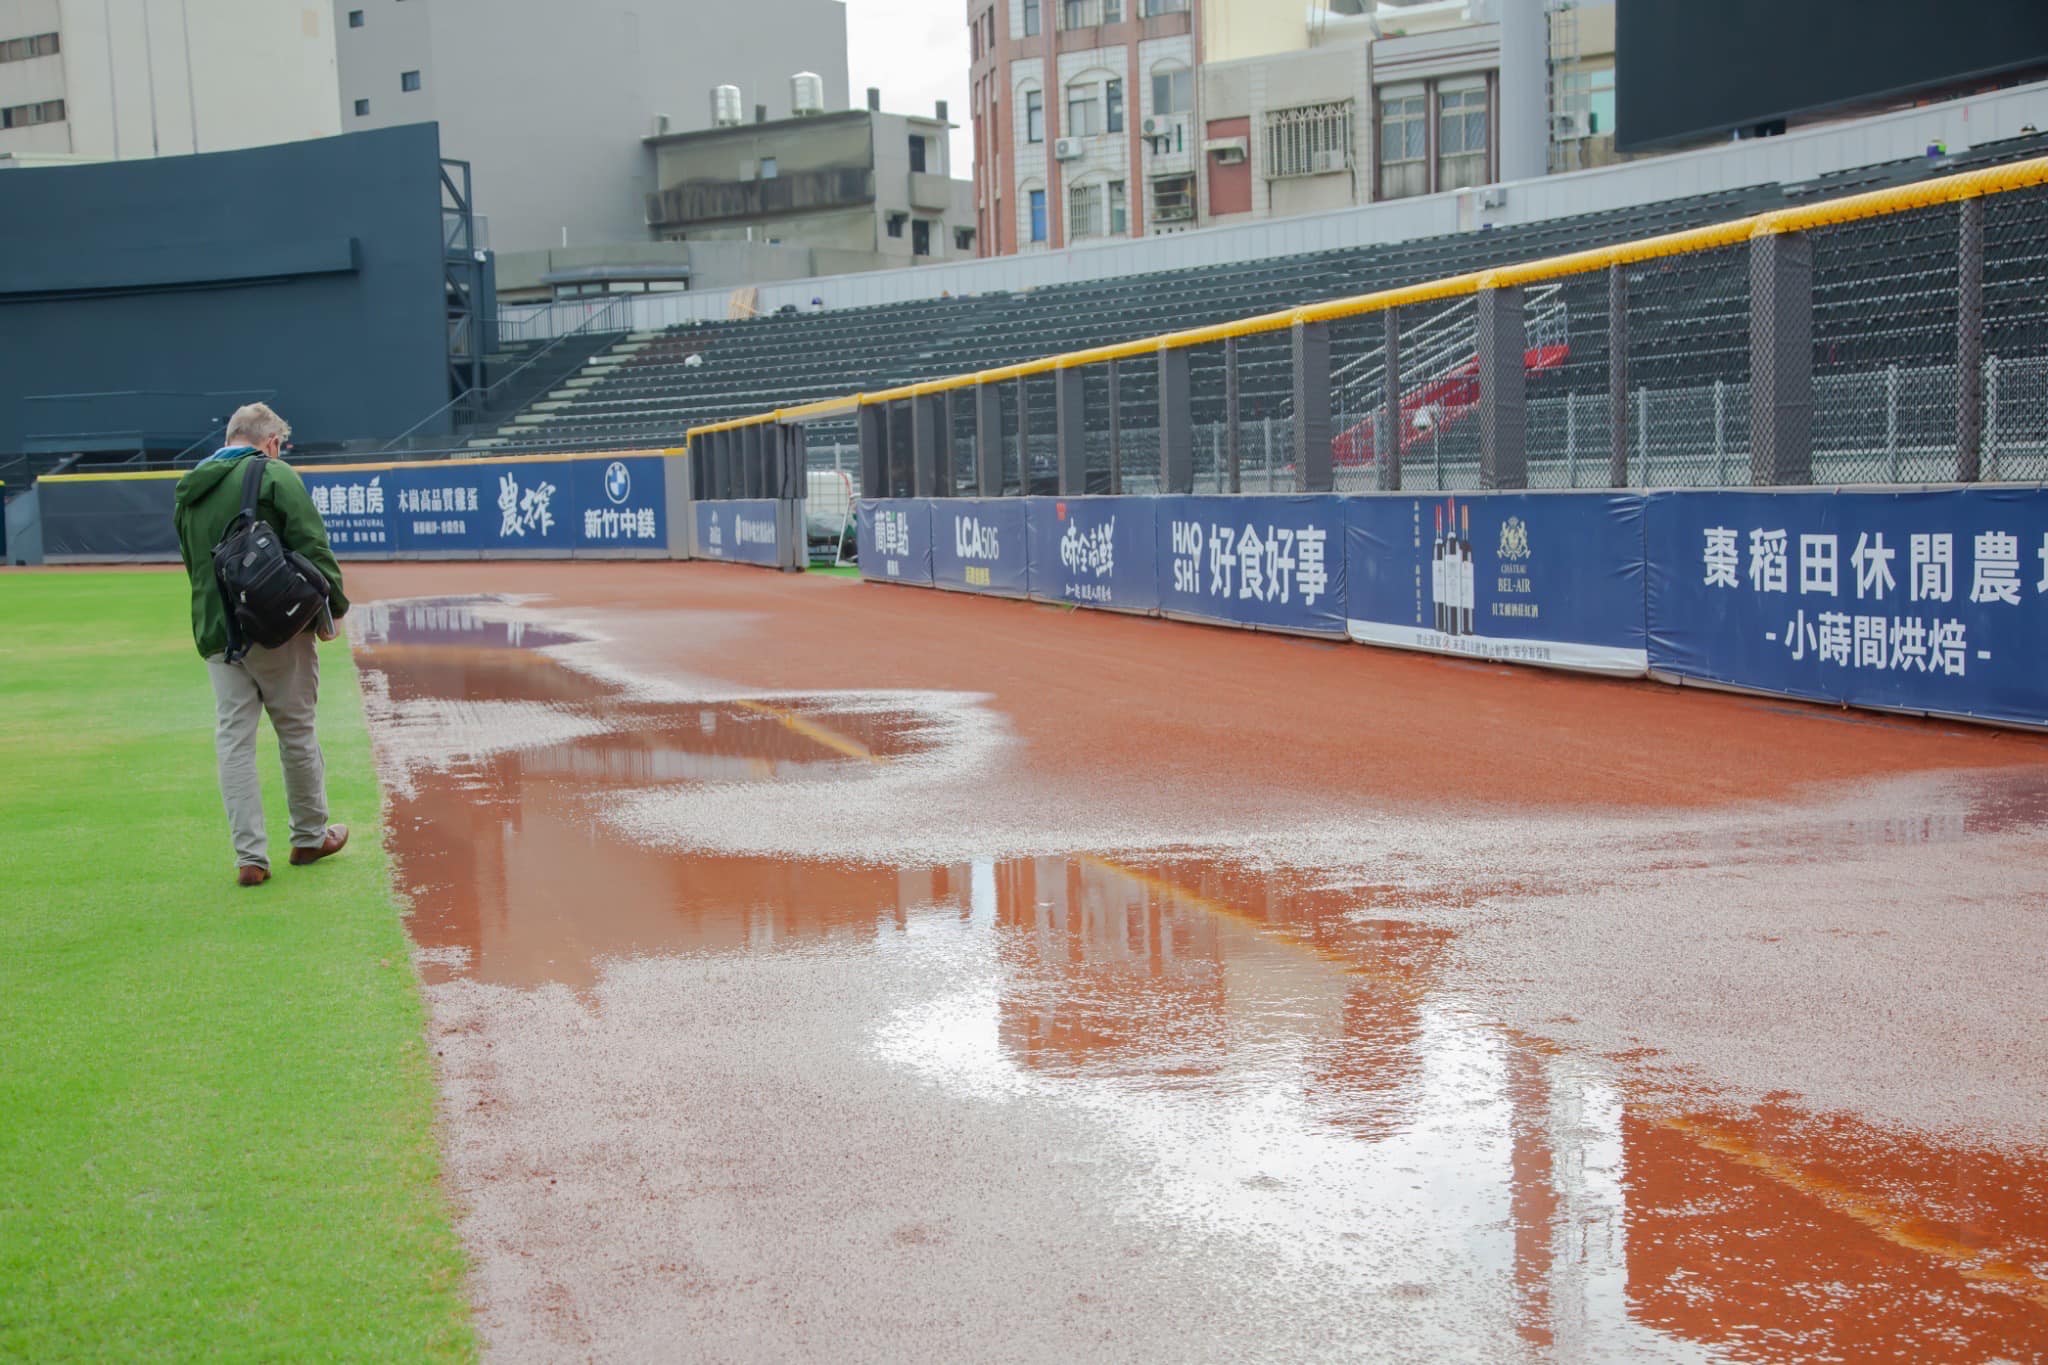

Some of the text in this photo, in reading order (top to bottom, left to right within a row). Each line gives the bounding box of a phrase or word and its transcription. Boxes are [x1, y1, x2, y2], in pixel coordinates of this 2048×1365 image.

[584, 508, 656, 539] 新竹中鎂
[1209, 523, 1329, 606] 好食好事
[1498, 577, 1531, 593] BEL-AIR
